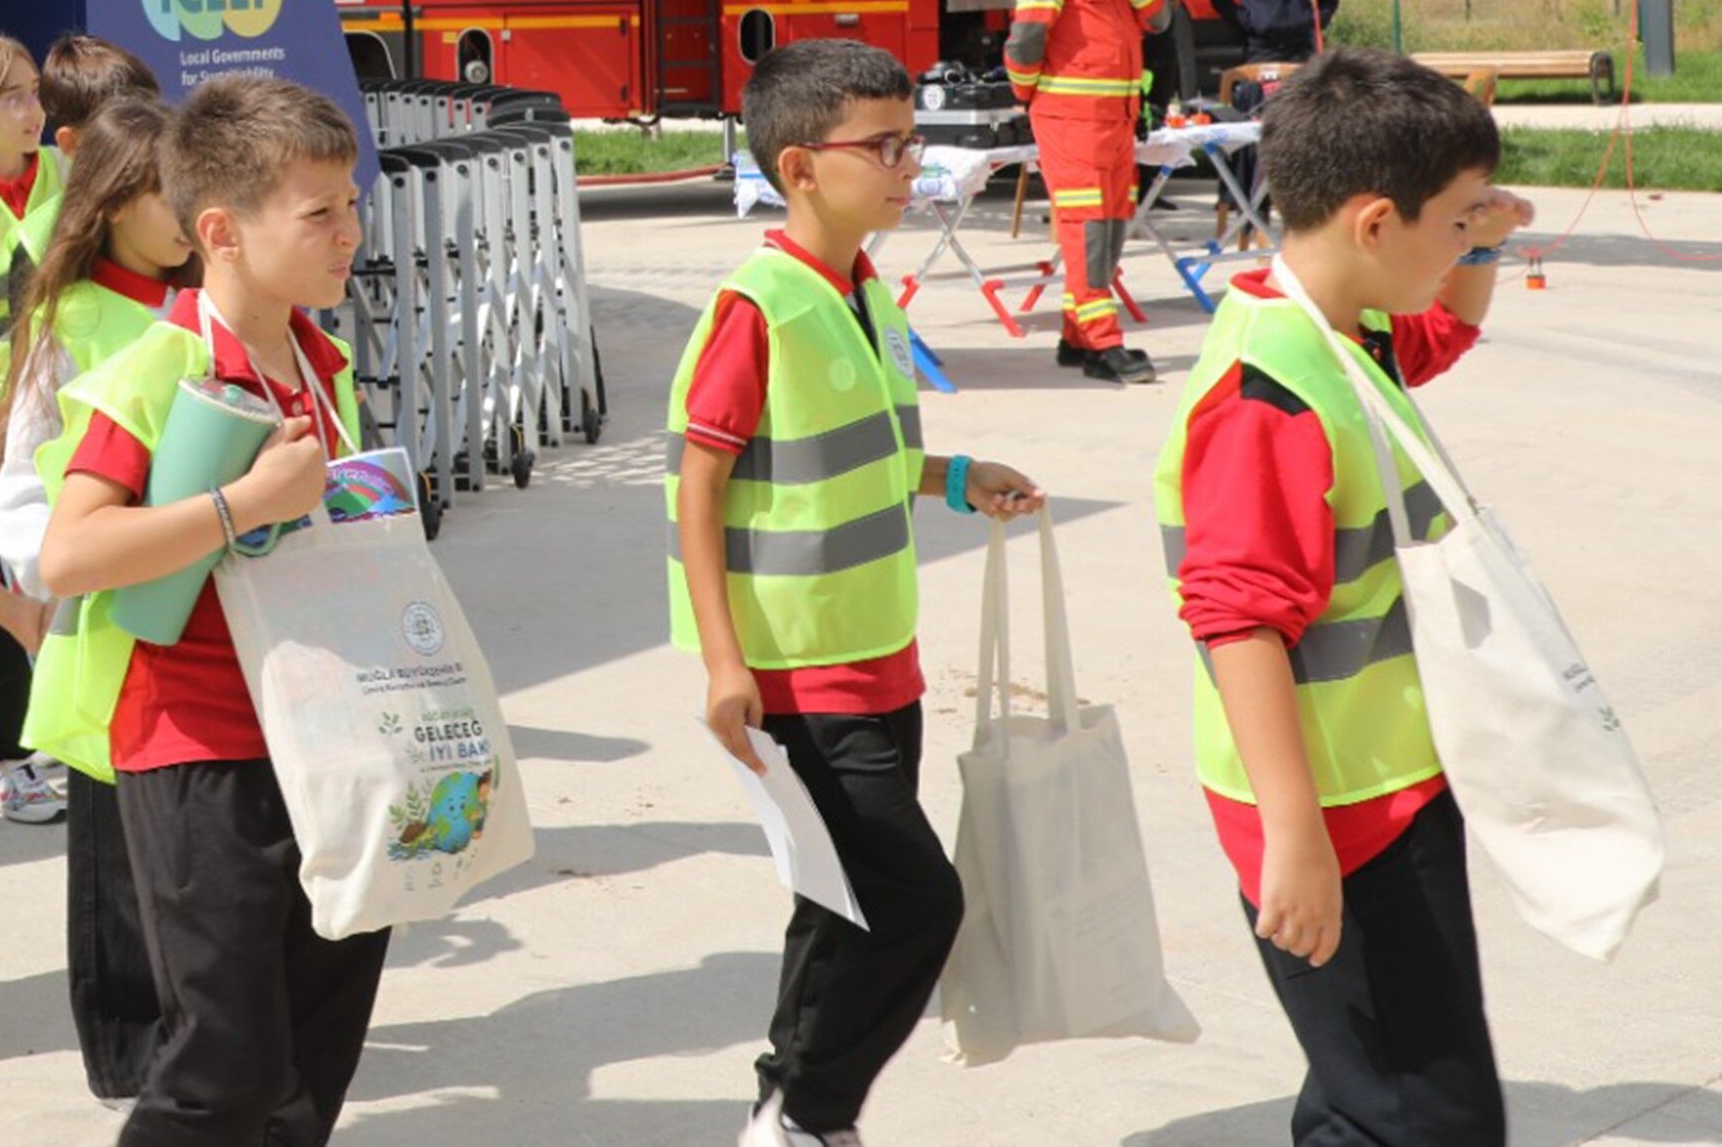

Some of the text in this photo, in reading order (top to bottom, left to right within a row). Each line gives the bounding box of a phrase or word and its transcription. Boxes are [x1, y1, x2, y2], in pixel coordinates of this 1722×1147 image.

[180, 47, 286, 66] Local Governments
[181, 70, 197, 86] for
